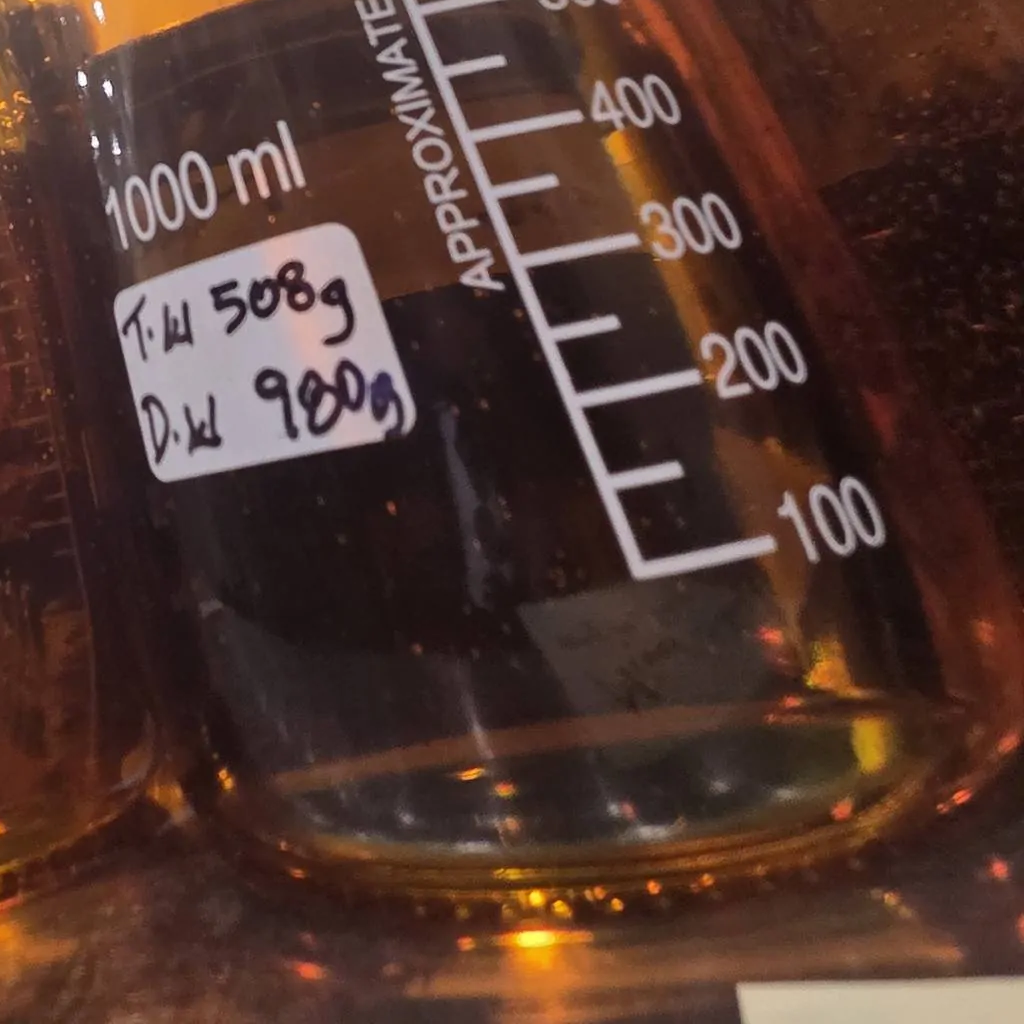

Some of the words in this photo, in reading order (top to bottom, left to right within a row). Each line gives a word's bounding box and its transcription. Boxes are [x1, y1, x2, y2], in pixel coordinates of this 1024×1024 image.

[590, 74, 681, 132] 400
[105, 151, 218, 251] 1000
[227, 120, 306, 206] ml
[640, 192, 742, 262] 300
[701, 320, 808, 400] 200
[778, 476, 886, 564] 100
